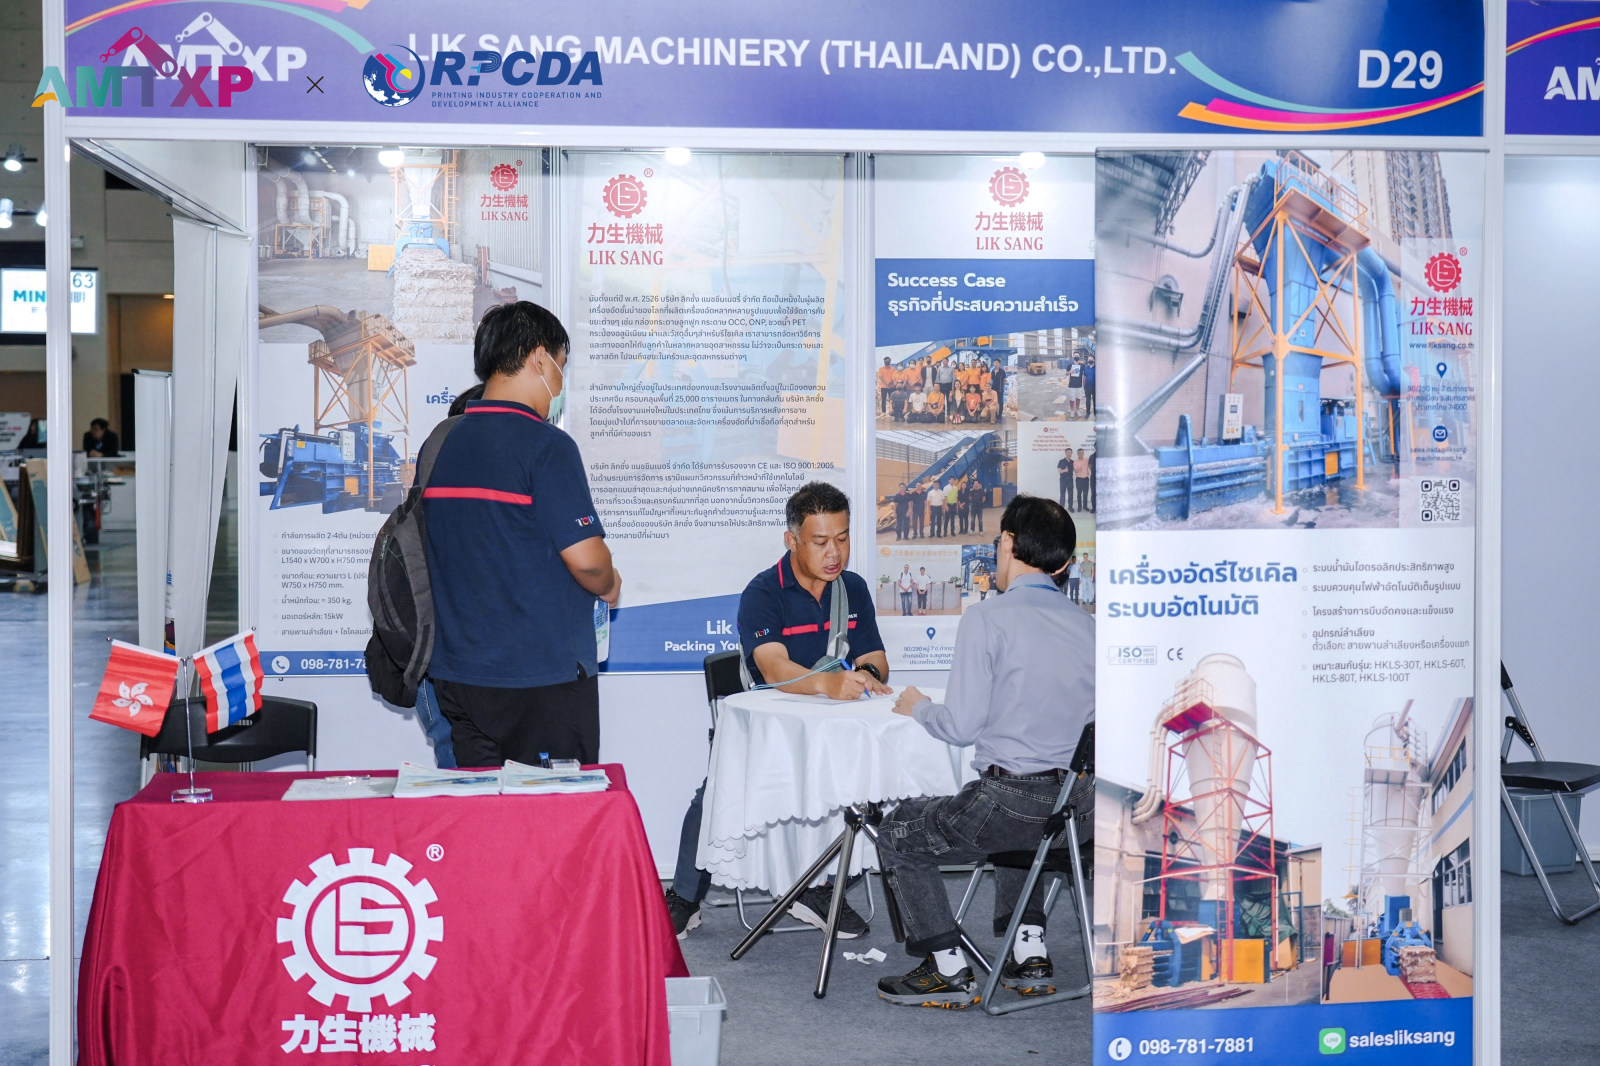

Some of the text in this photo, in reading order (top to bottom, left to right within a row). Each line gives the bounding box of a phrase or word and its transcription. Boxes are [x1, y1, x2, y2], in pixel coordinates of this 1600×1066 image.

[408, 33, 1177, 78] LIK SANG MACHINERY (THAILAND) CO.,LTD.
[1358, 49, 1444, 90] D29
[480, 194, 528, 208] 力生機械
[481, 211, 528, 221] LIK SANG
[974, 211, 1044, 232] 力生機械
[587, 222, 664, 245] 力生機械
[976, 236, 1044, 250] LIK SANG
[589, 250, 664, 265] LIK SANG
[72, 272, 94, 288] 63
[887, 272, 1006, 288] Success Case
[12, 290, 46, 302] MIN
[888, 291, 1079, 316] ธุรกิจที่ประสบความสำเร็จ
[1410, 296, 1473, 316] 力生機械
[728, 318, 748, 327] OCC,
[749, 318, 767, 327] ONP,
[1411, 322, 1472, 335] LIK SANG
[1409, 342, 1474, 350] www.liksang.co.th
[675, 396, 700, 404] 25,000
[1109, 554, 1298, 584] เครื่องอัดรีไซเคิล
[342, 597, 353, 606] kg.
[1108, 593, 1259, 618] ระบบอัตโนมัติ
[706, 619, 733, 635] Lik
[664, 640, 716, 654] Packing
[1118, 647, 1142, 658] ISO
[1167, 647, 1184, 661] CE
[1374, 660, 1422, 671] HKLS-30T,
[1424, 659, 1466, 670] HKLS-60T,
[1312, 672, 1410, 684] HKLS-80T, HKLS-100T
[280, 1012, 436, 1054] 力生機械
[1348, 1029, 1455, 1050] salesliksang
[1139, 1037, 1254, 1056] 098-781-7881
